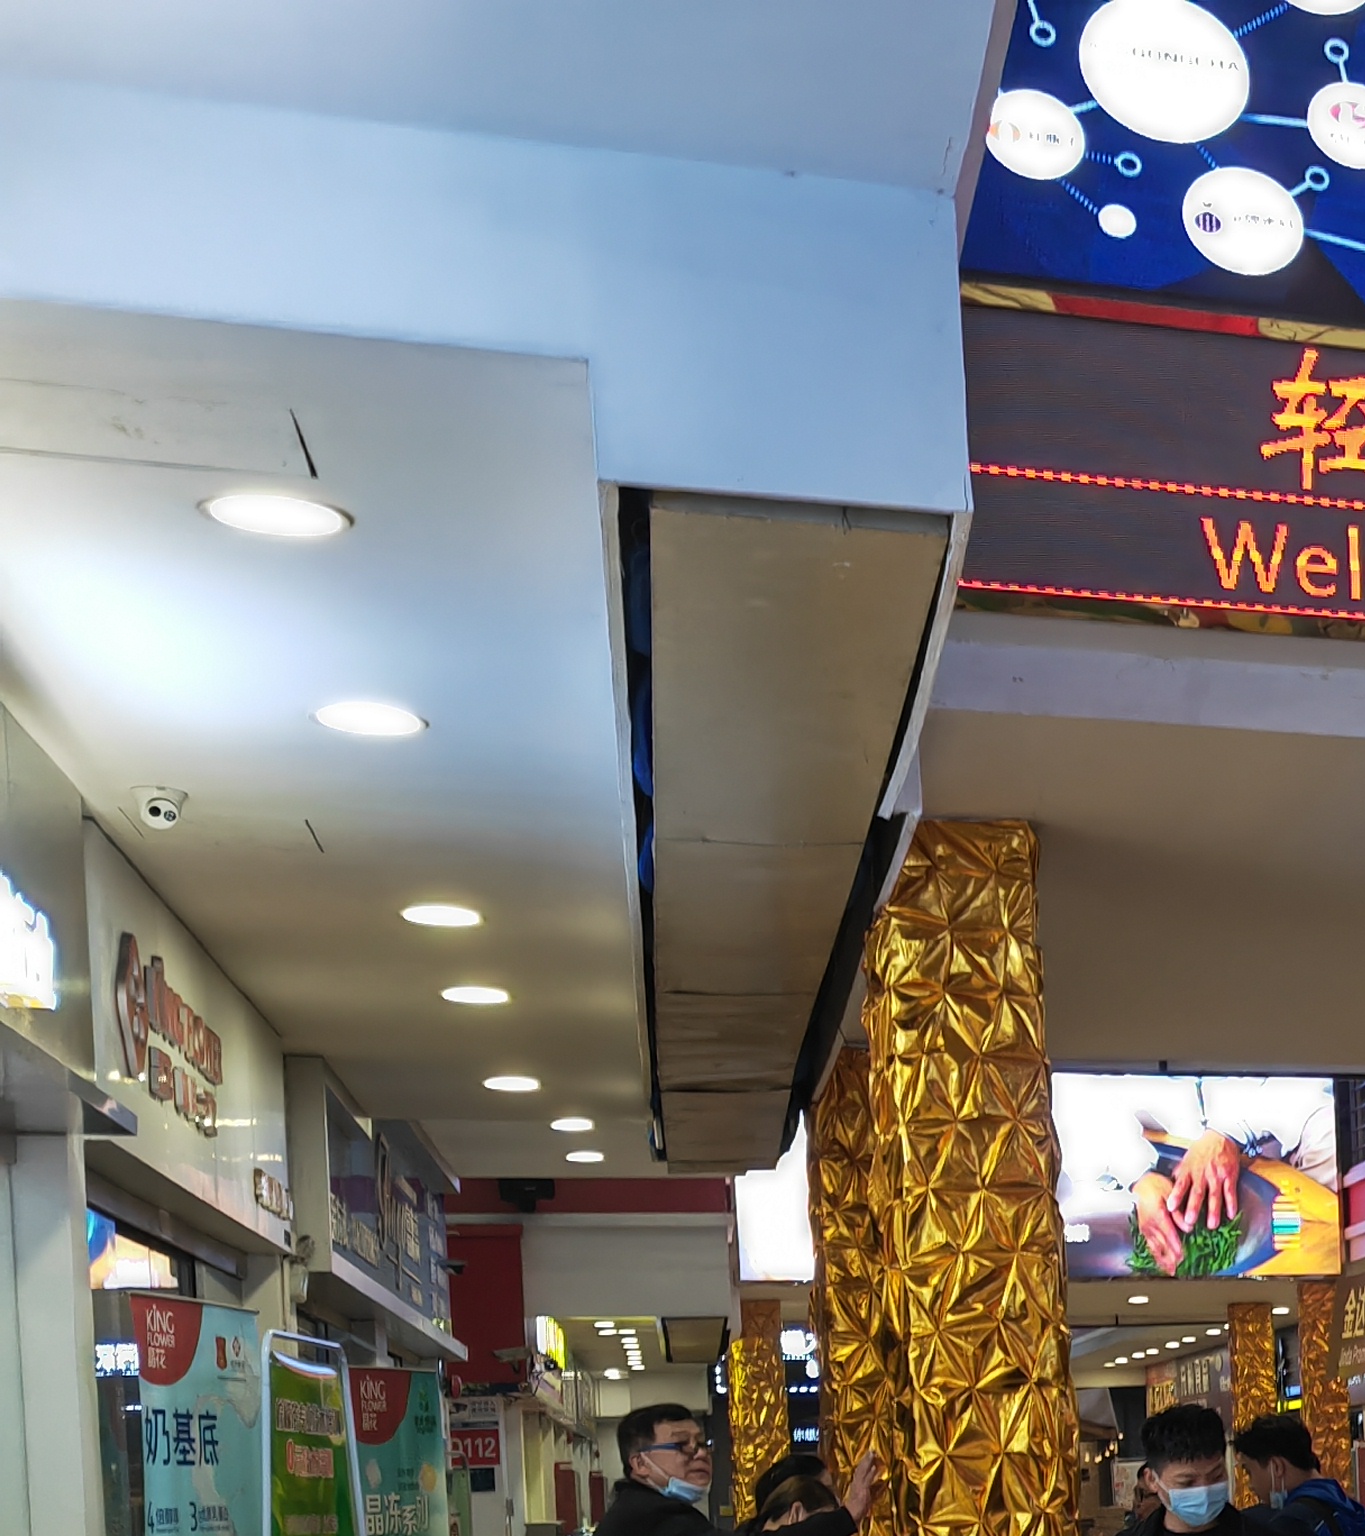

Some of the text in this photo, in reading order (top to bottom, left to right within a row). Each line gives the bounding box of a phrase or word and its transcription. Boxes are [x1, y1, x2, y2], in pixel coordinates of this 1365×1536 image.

[147, 1331, 175, 1348] FLOWER
[145, 1405, 219, 1467] 奶基底
[366, 1491, 430, 1536] 晶冻系列
